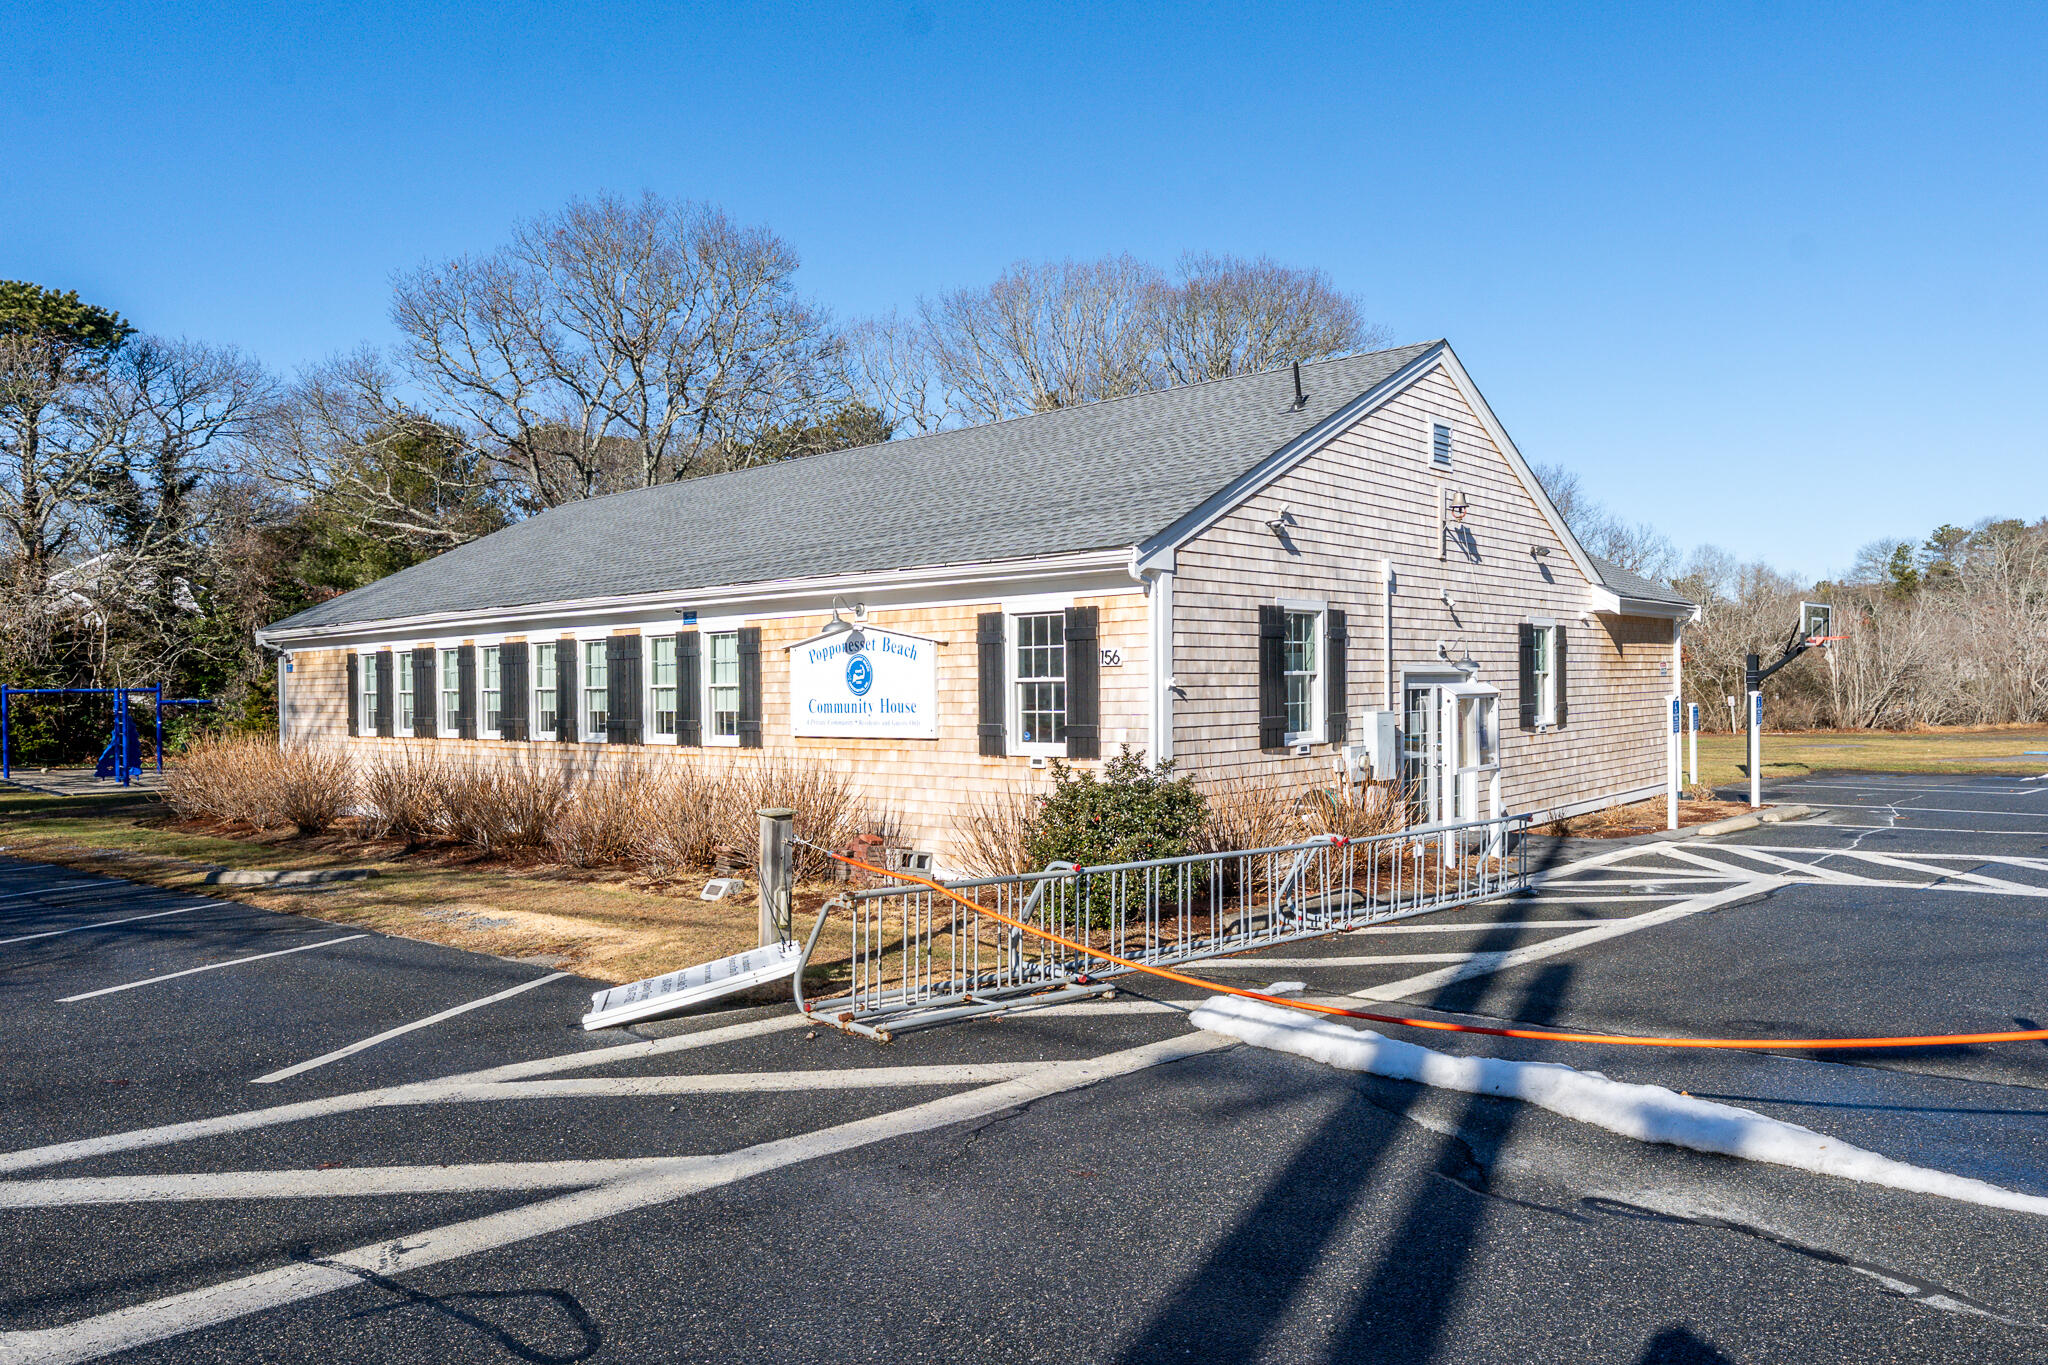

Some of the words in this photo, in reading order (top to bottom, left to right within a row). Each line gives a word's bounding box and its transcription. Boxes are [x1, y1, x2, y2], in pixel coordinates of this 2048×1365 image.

[808, 637, 876, 664] Popponesset
[882, 636, 918, 661] Beach
[1100, 649, 1121, 666] 156
[808, 698, 873, 717] Community
[880, 697, 918, 714] House
